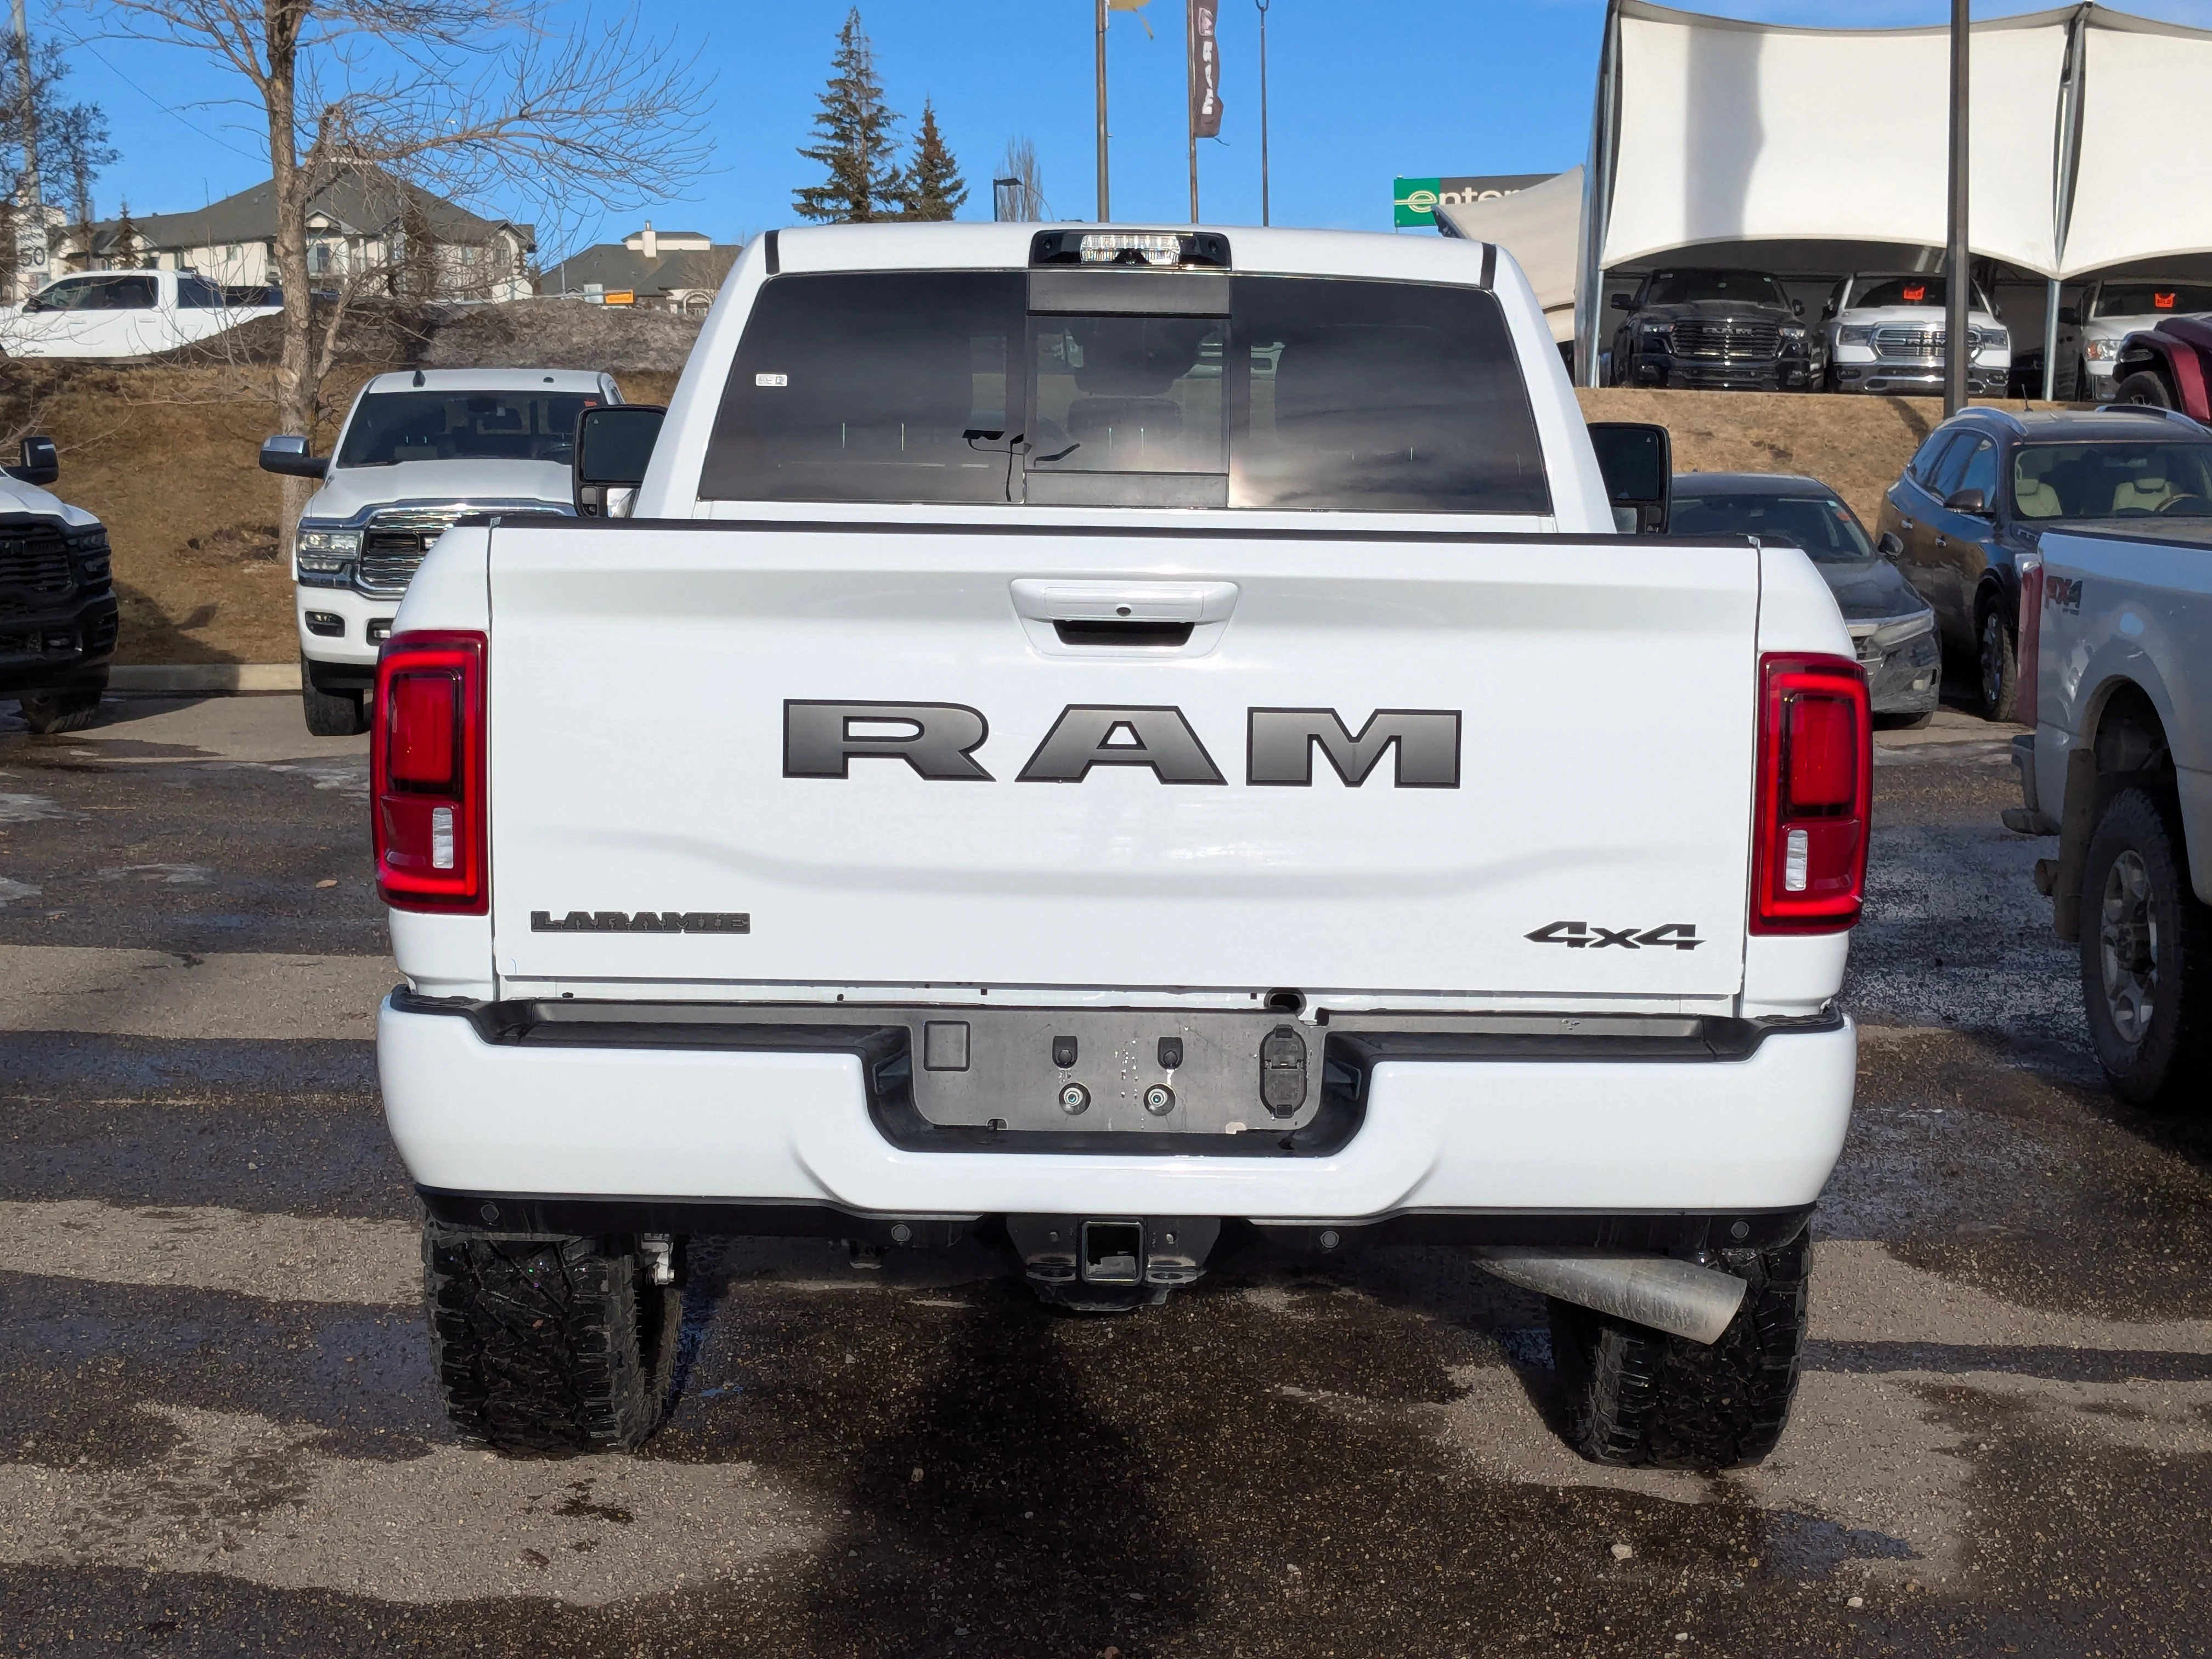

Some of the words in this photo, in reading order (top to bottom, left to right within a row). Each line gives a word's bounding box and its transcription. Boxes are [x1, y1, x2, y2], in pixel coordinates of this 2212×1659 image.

[783, 699, 1463, 789] RAM
[531, 911, 751, 934] LARAMIE
[1523, 921, 1707, 950] 4x4
